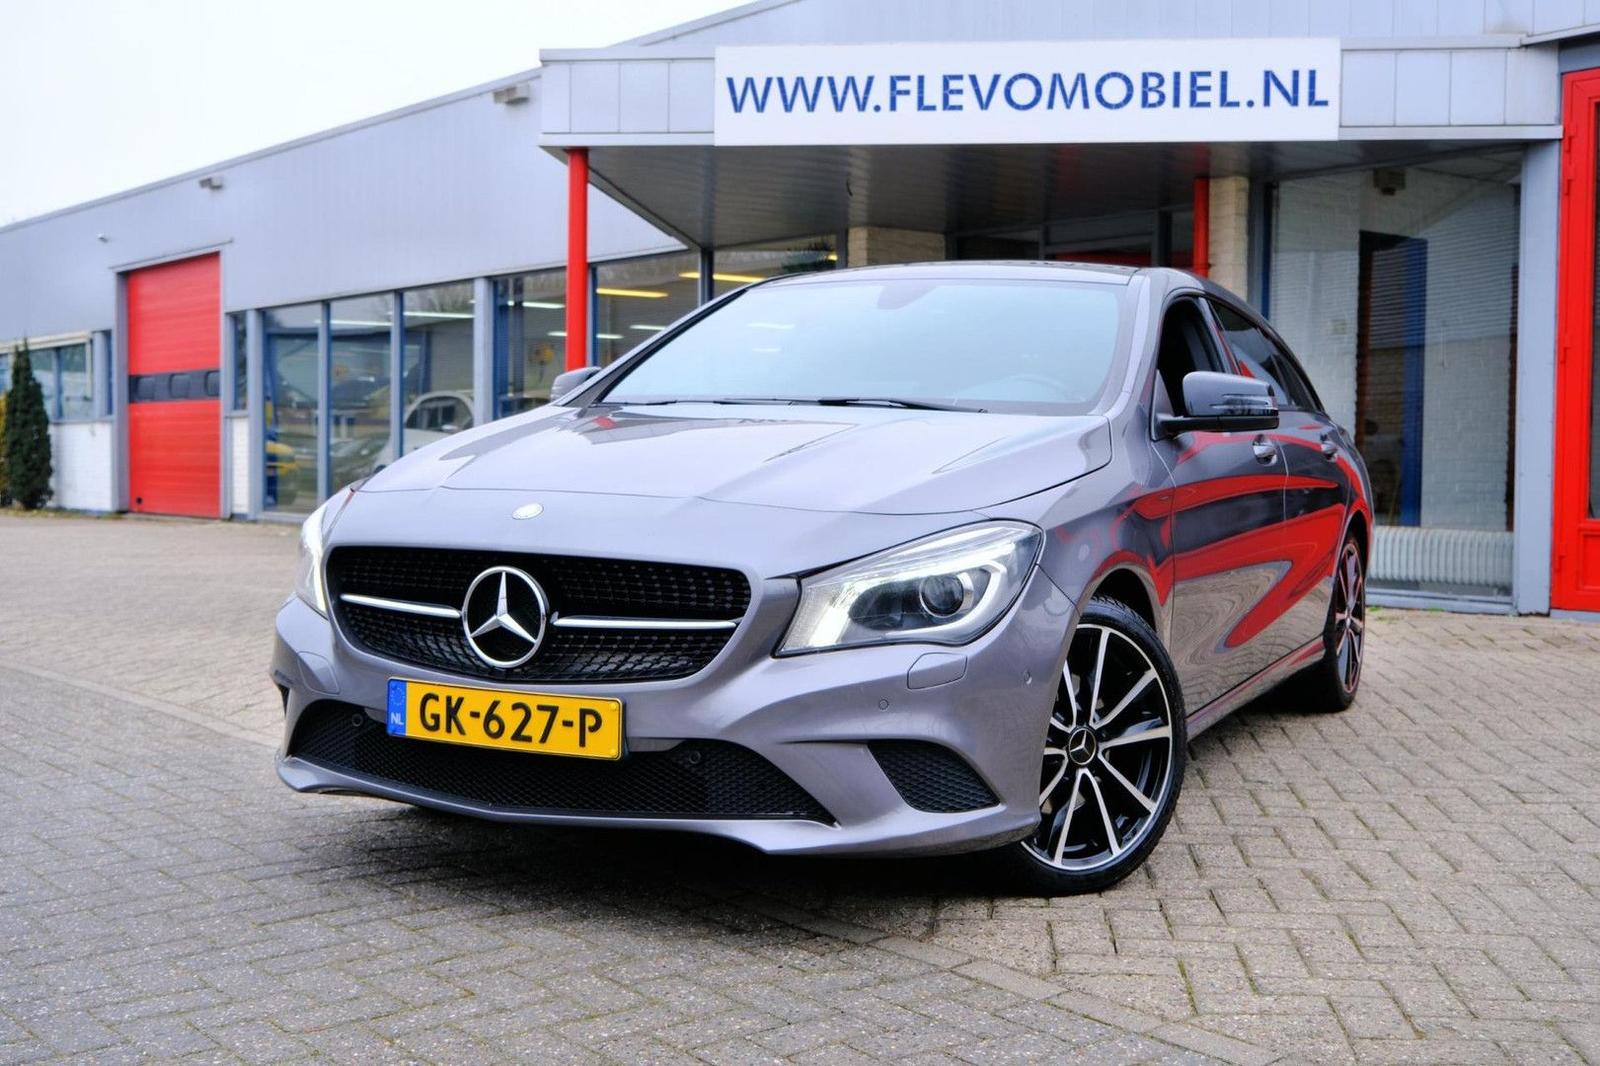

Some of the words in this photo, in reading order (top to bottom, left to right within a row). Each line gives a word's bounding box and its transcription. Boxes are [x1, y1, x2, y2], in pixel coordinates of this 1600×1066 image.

[727, 69, 1329, 114] WWW.FLEVOMOBIEL.NL
[390, 713, 404, 725] NL
[419, 692, 603, 748] GK-627-P
